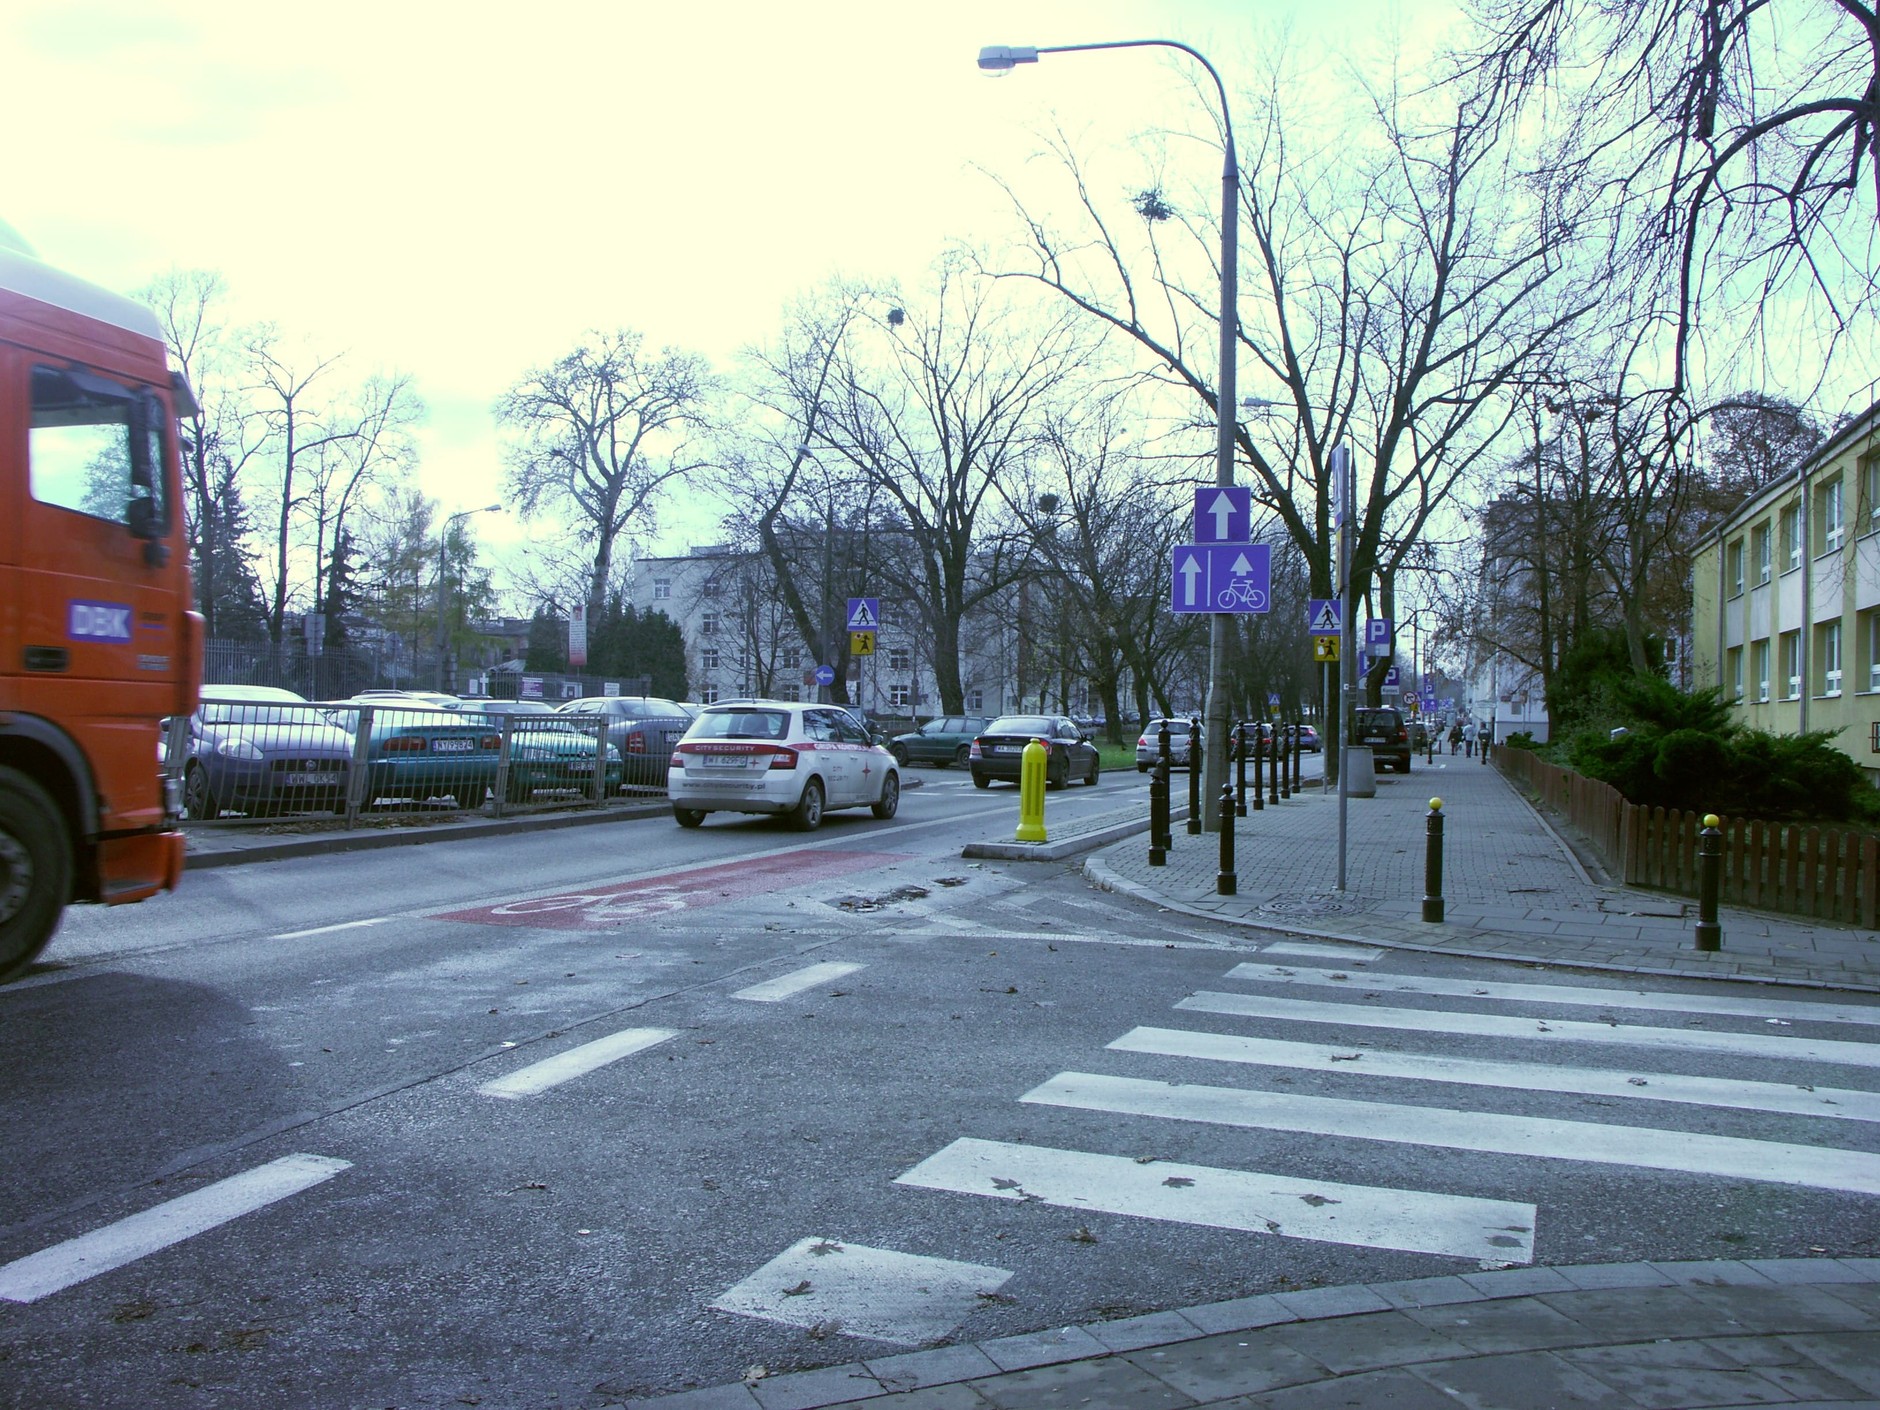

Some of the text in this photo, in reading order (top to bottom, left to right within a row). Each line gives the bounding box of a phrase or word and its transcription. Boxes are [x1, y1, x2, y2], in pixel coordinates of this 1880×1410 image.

[72, 604, 130, 638] DBK
[1371, 621, 1385, 641] P
[1385, 669, 1396, 684] P
